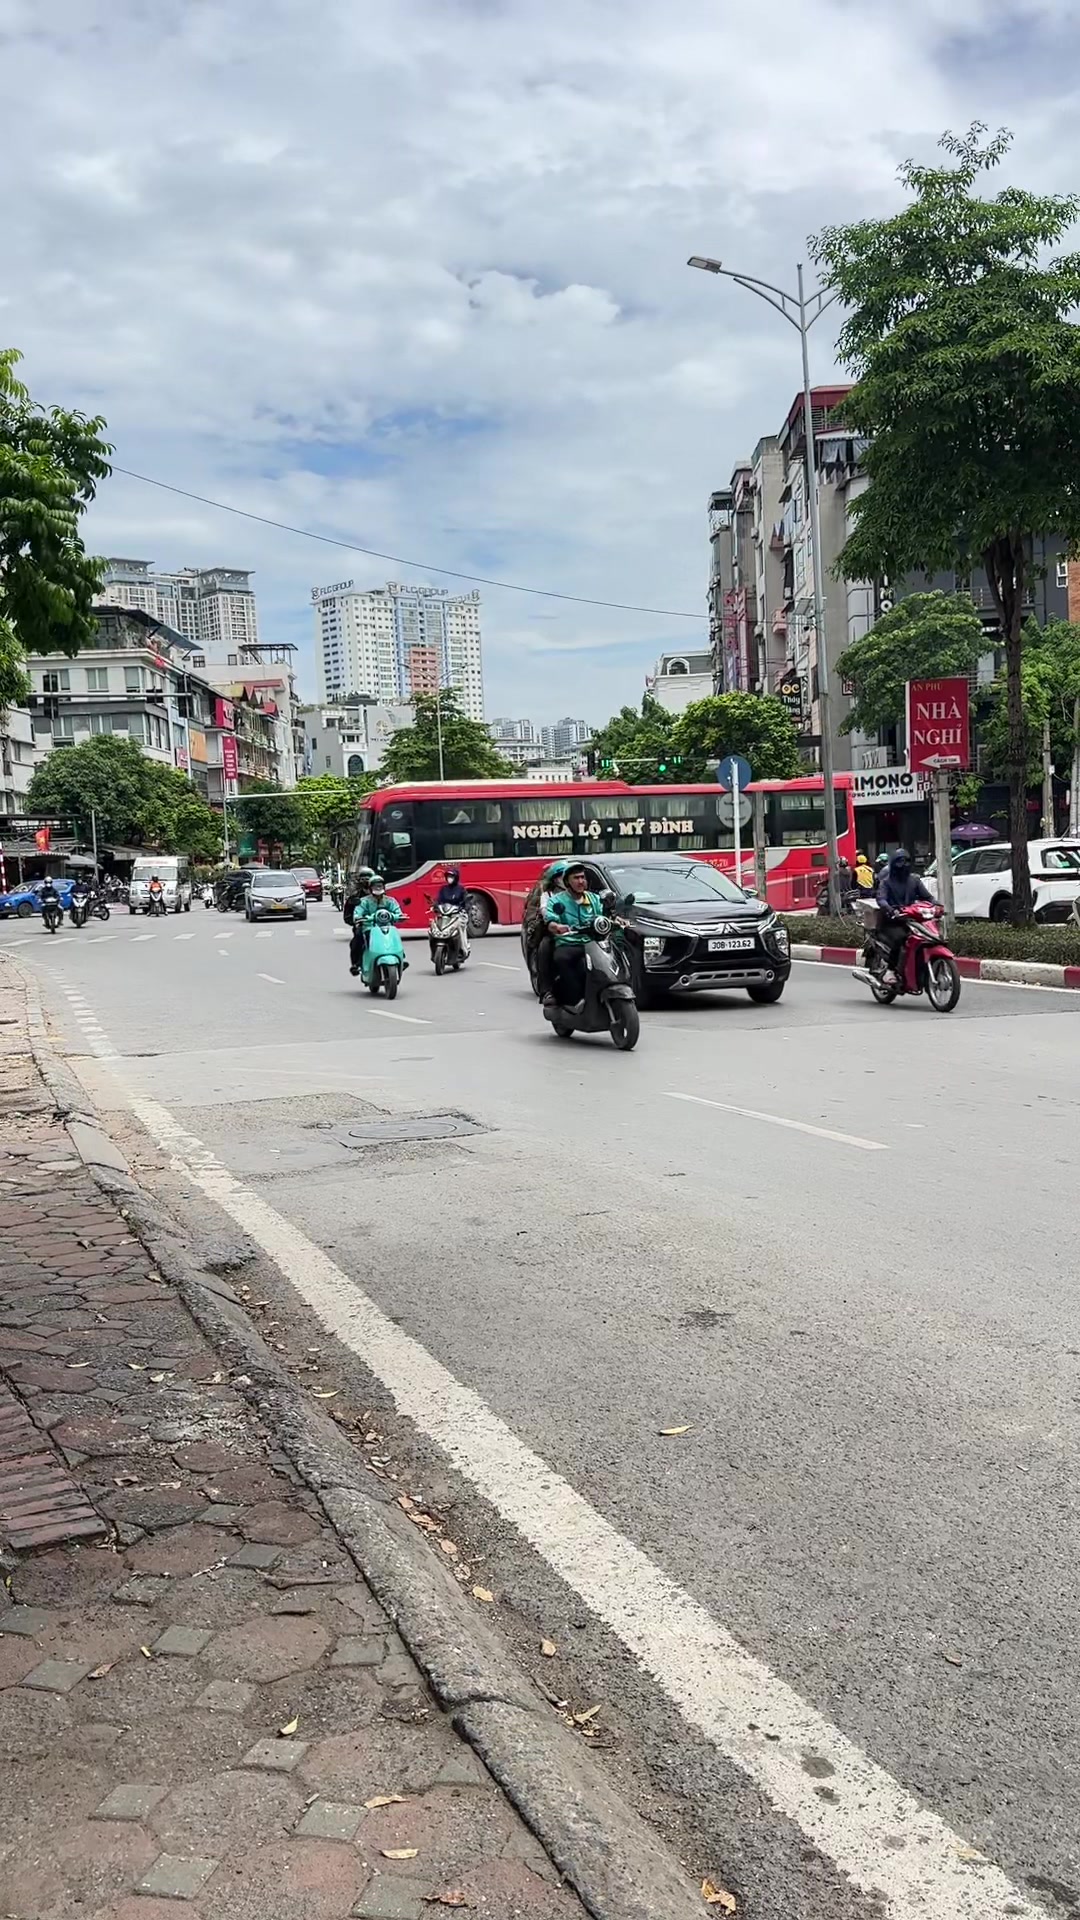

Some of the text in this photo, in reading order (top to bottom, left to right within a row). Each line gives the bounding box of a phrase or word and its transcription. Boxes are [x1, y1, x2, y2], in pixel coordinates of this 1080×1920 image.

[916, 696, 962, 720] NHÀ
[854, 773, 913, 791] IMONO
[512, 819, 574, 839] NGHĨA
[577, 819, 602, 840] LỘ
[619, 818, 646, 836] MỸ
[649, 817, 694, 835] ĐÌNH
